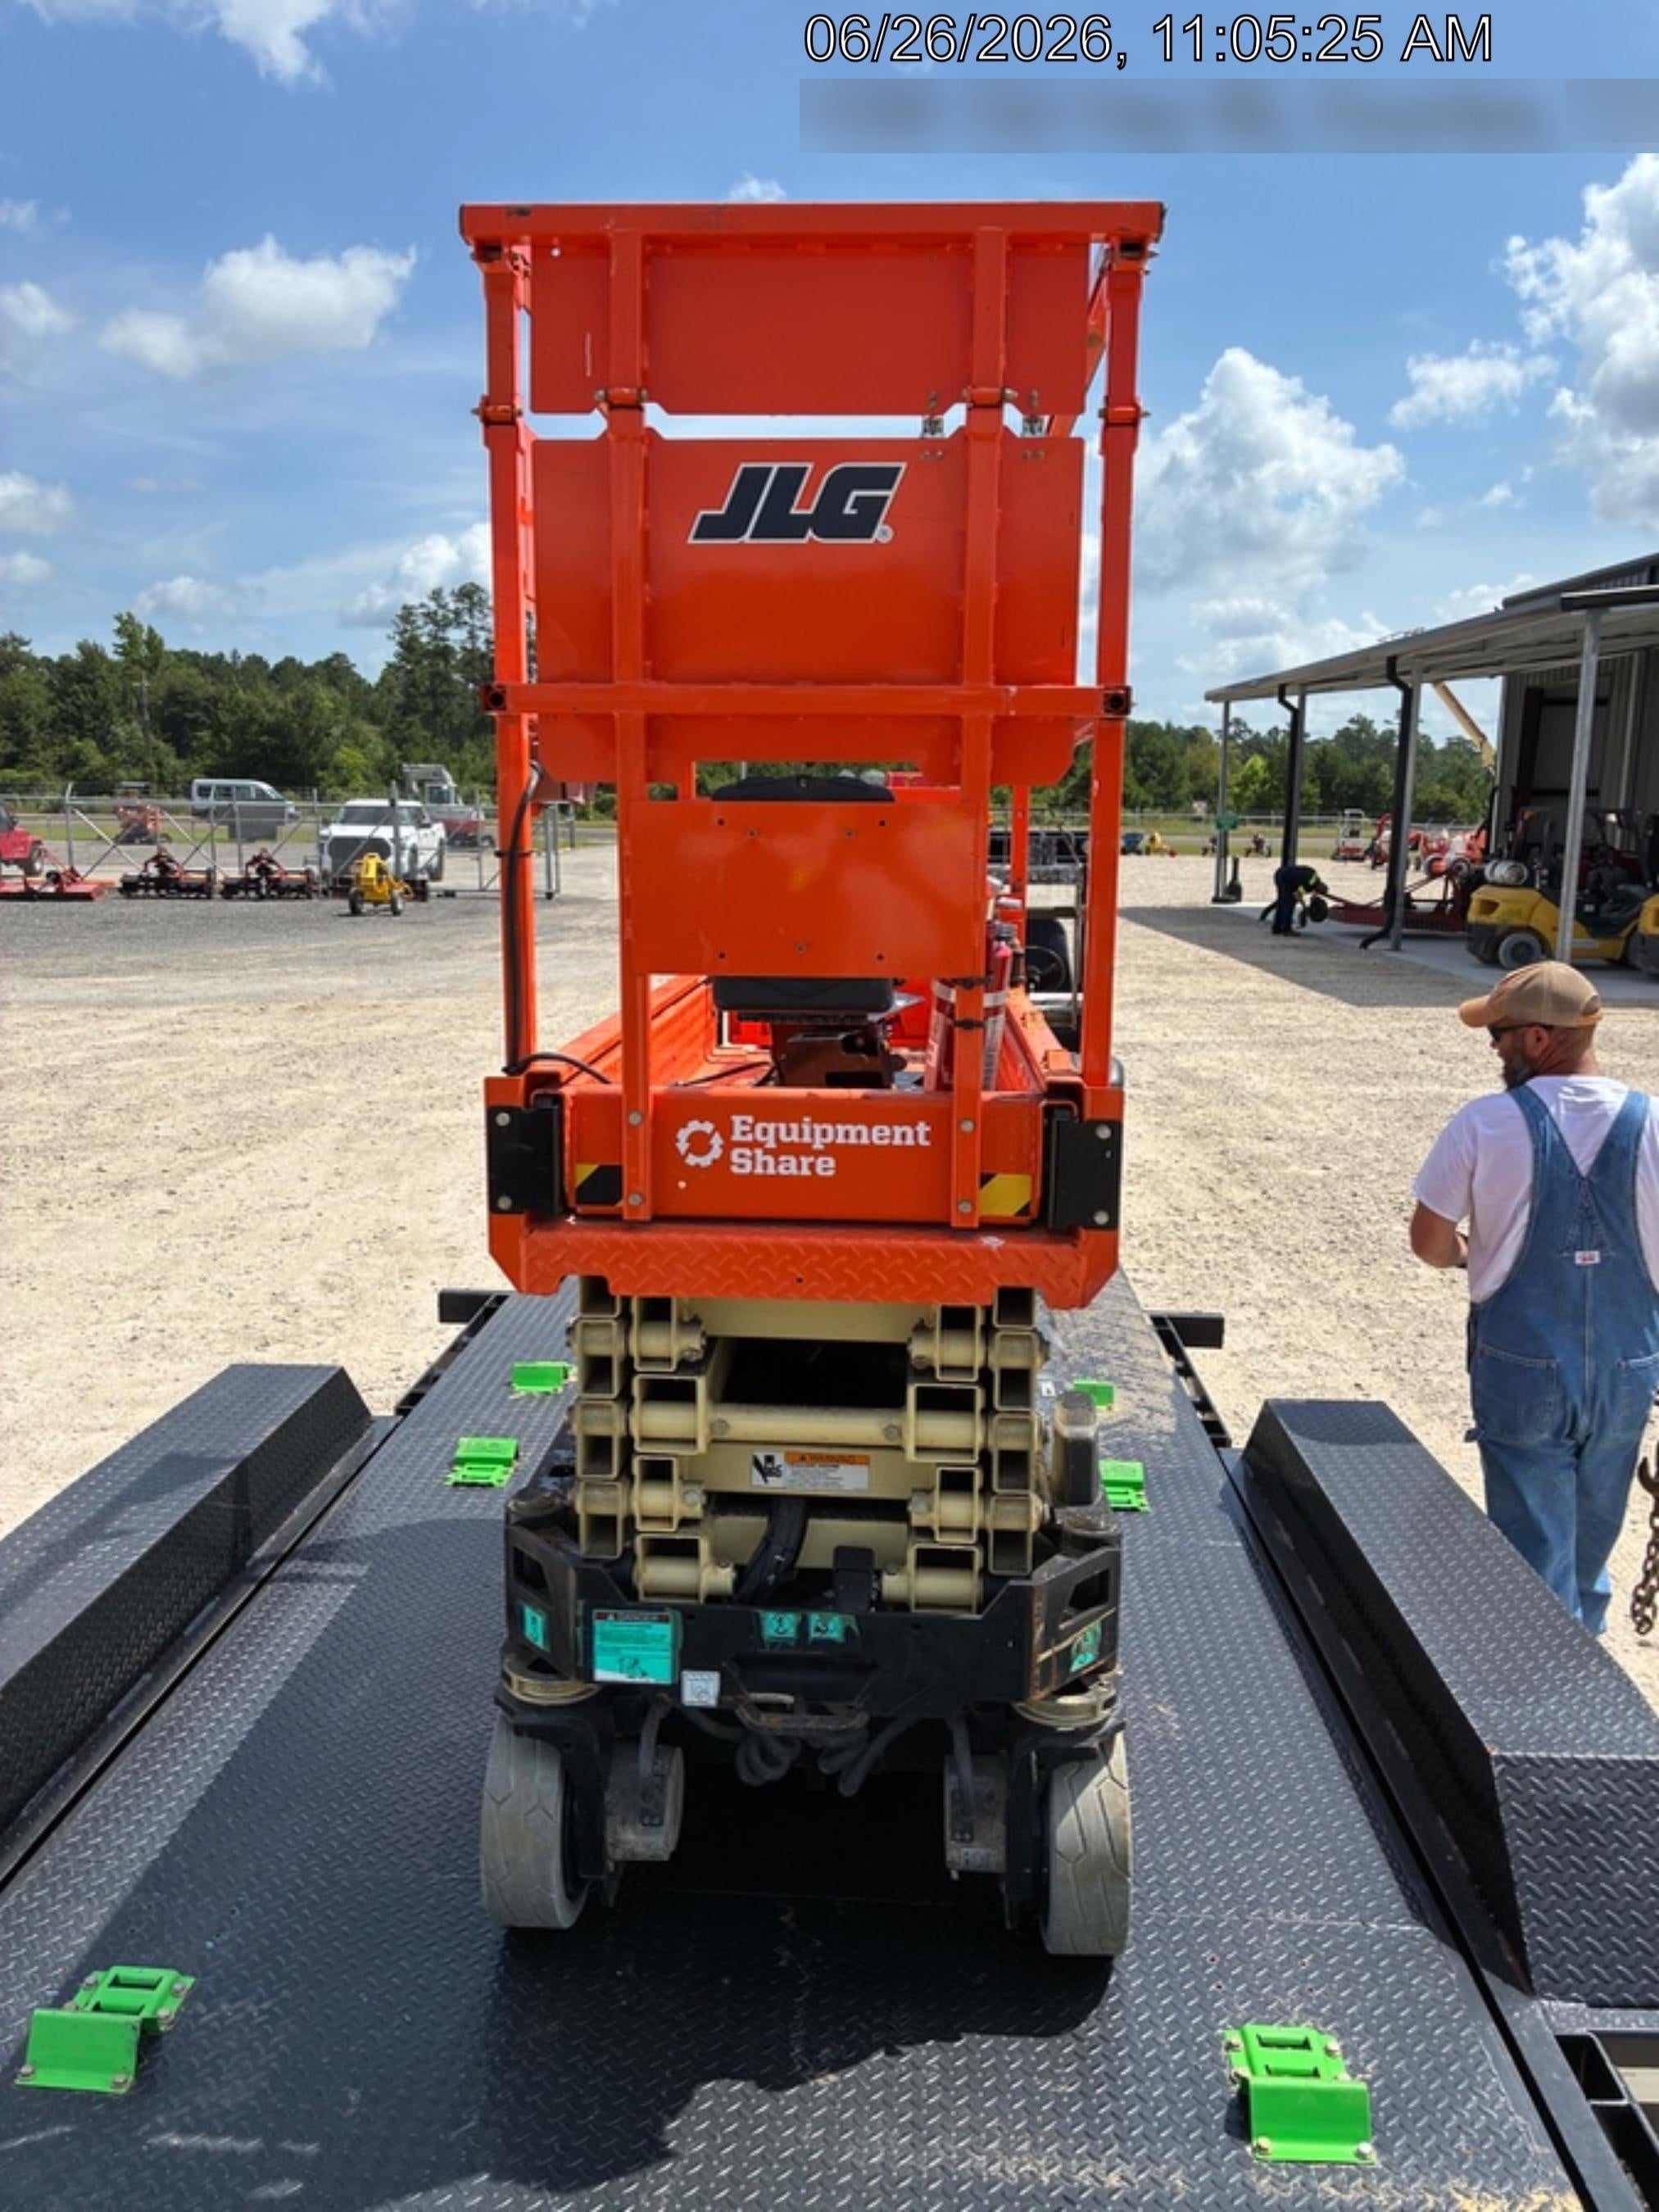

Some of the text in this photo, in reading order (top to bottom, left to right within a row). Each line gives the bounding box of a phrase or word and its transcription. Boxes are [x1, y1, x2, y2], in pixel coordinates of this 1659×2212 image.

[687, 461, 906, 544] JLG
[730, 1115, 931, 1150] Equipment
[730, 1147, 836, 1176] Share
